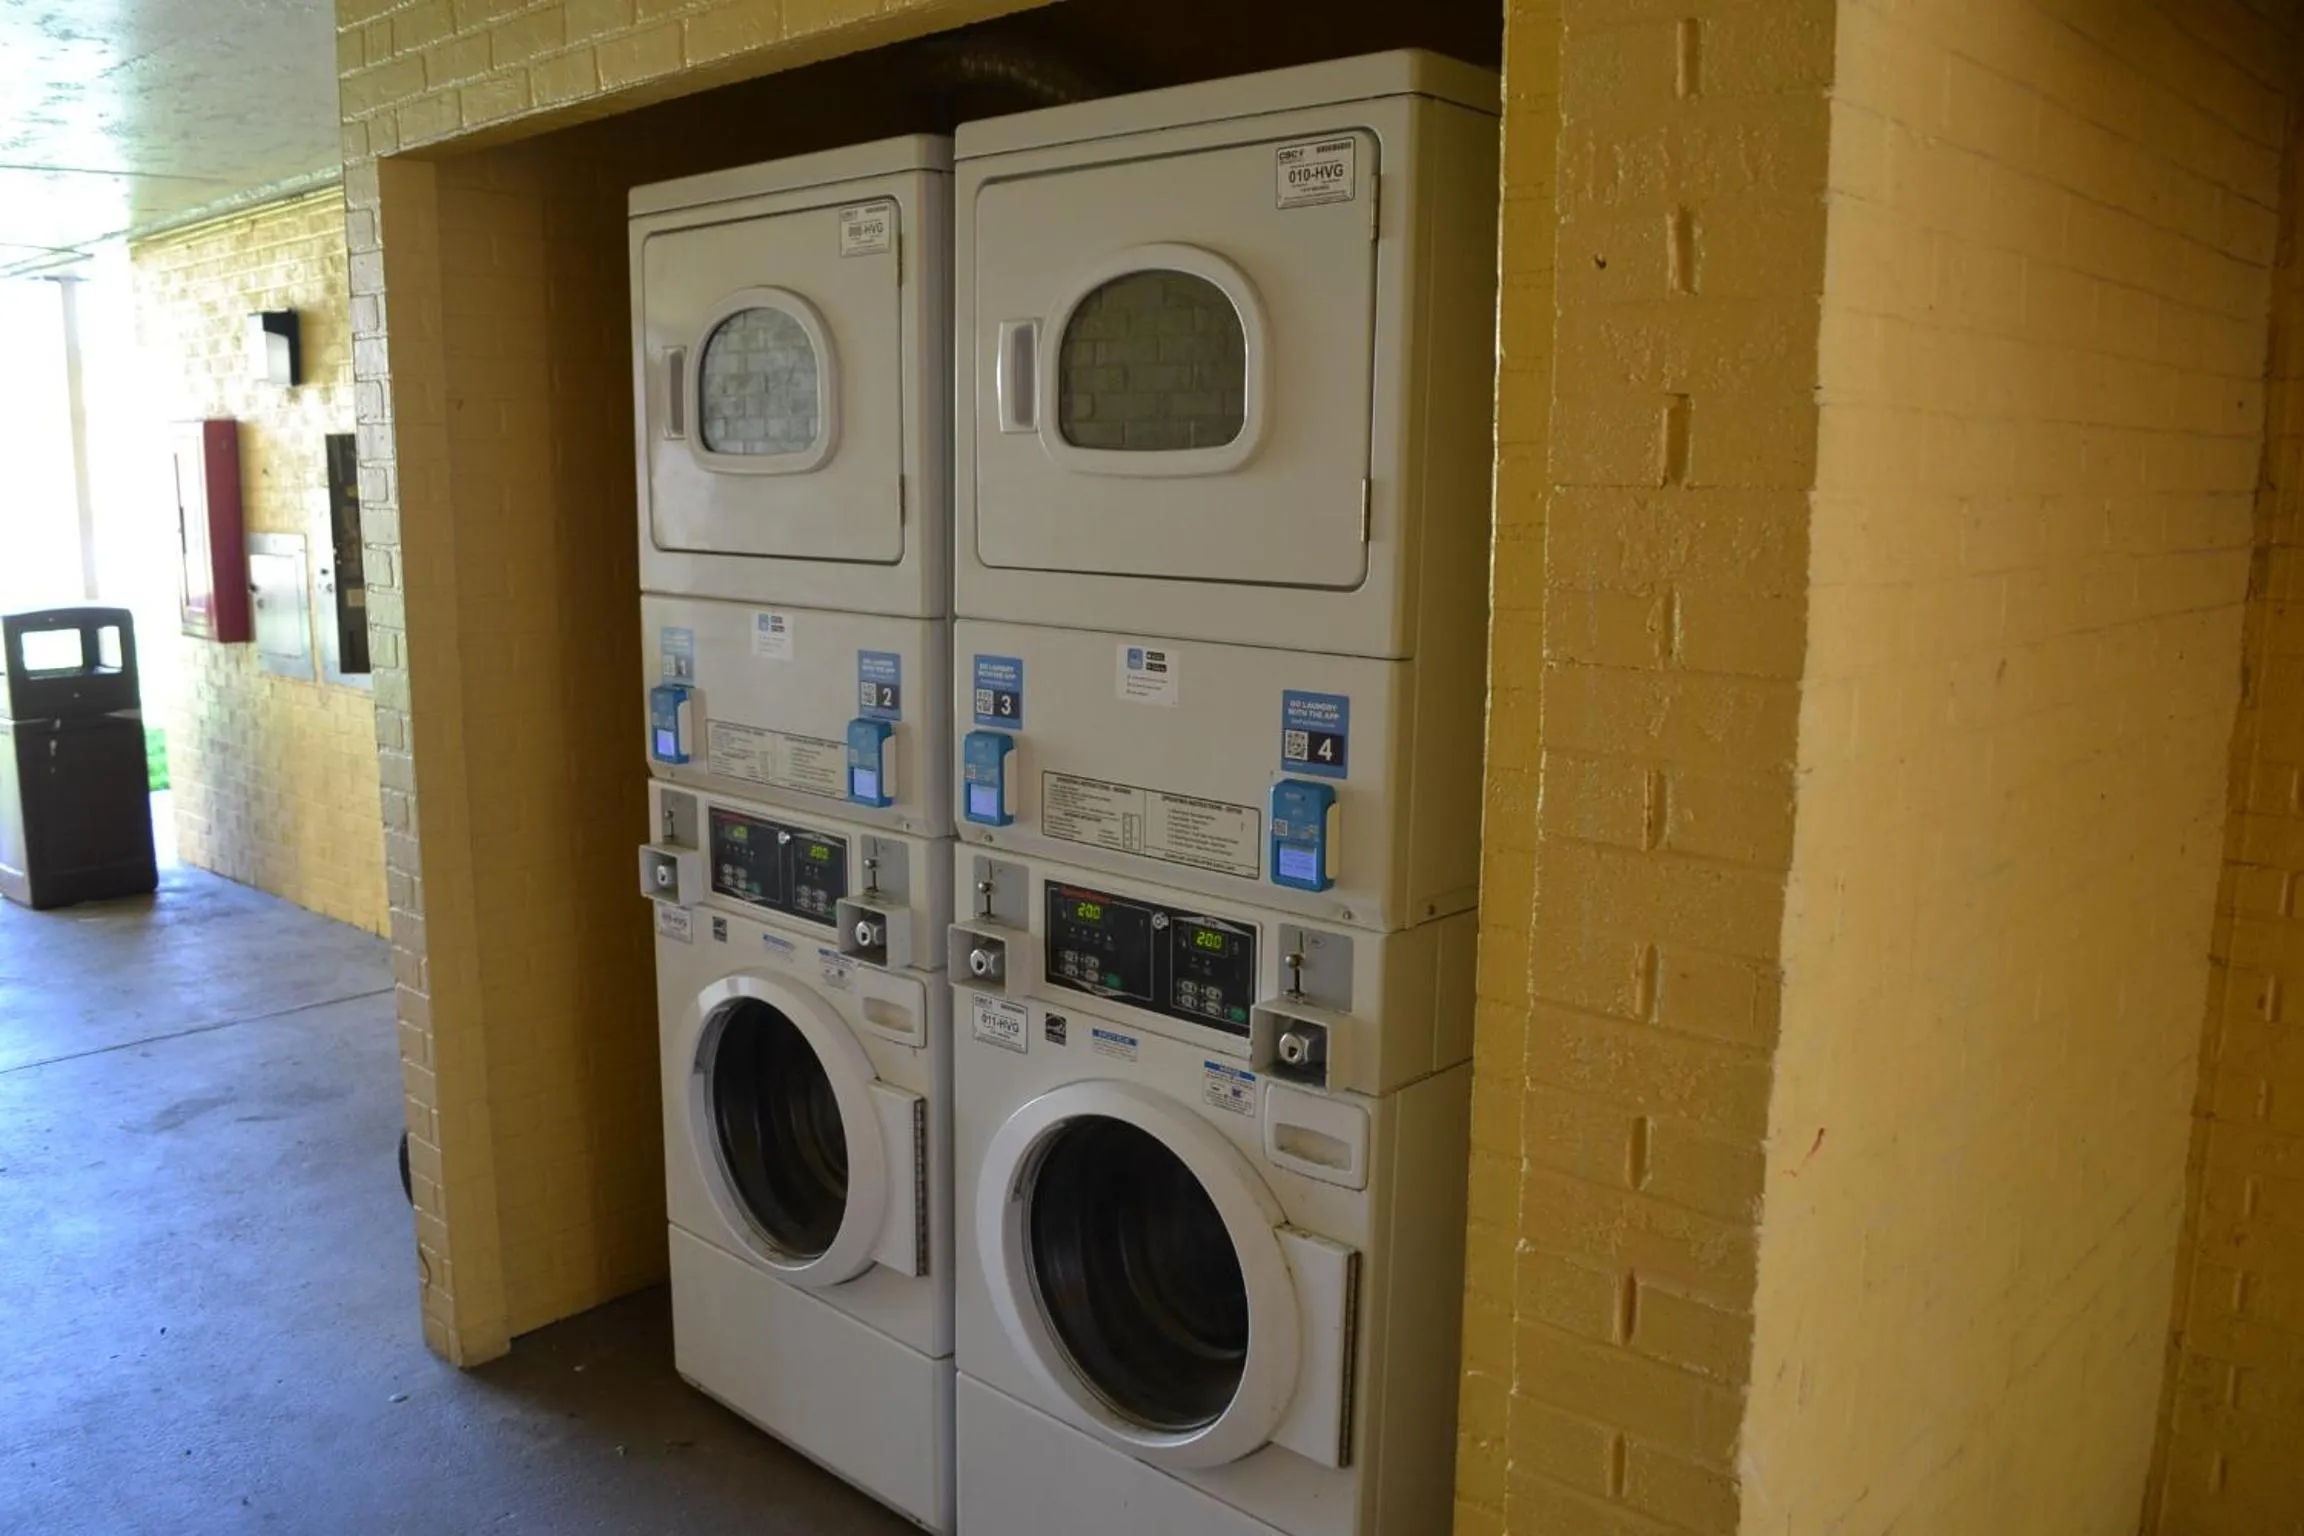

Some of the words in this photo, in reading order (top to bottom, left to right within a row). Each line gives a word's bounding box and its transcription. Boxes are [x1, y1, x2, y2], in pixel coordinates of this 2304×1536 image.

[1288, 163, 1344, 184] 010-HVG
[882, 687, 893, 707] 2
[1000, 695, 1012, 716] 3
[1317, 736, 1333, 762] 4
